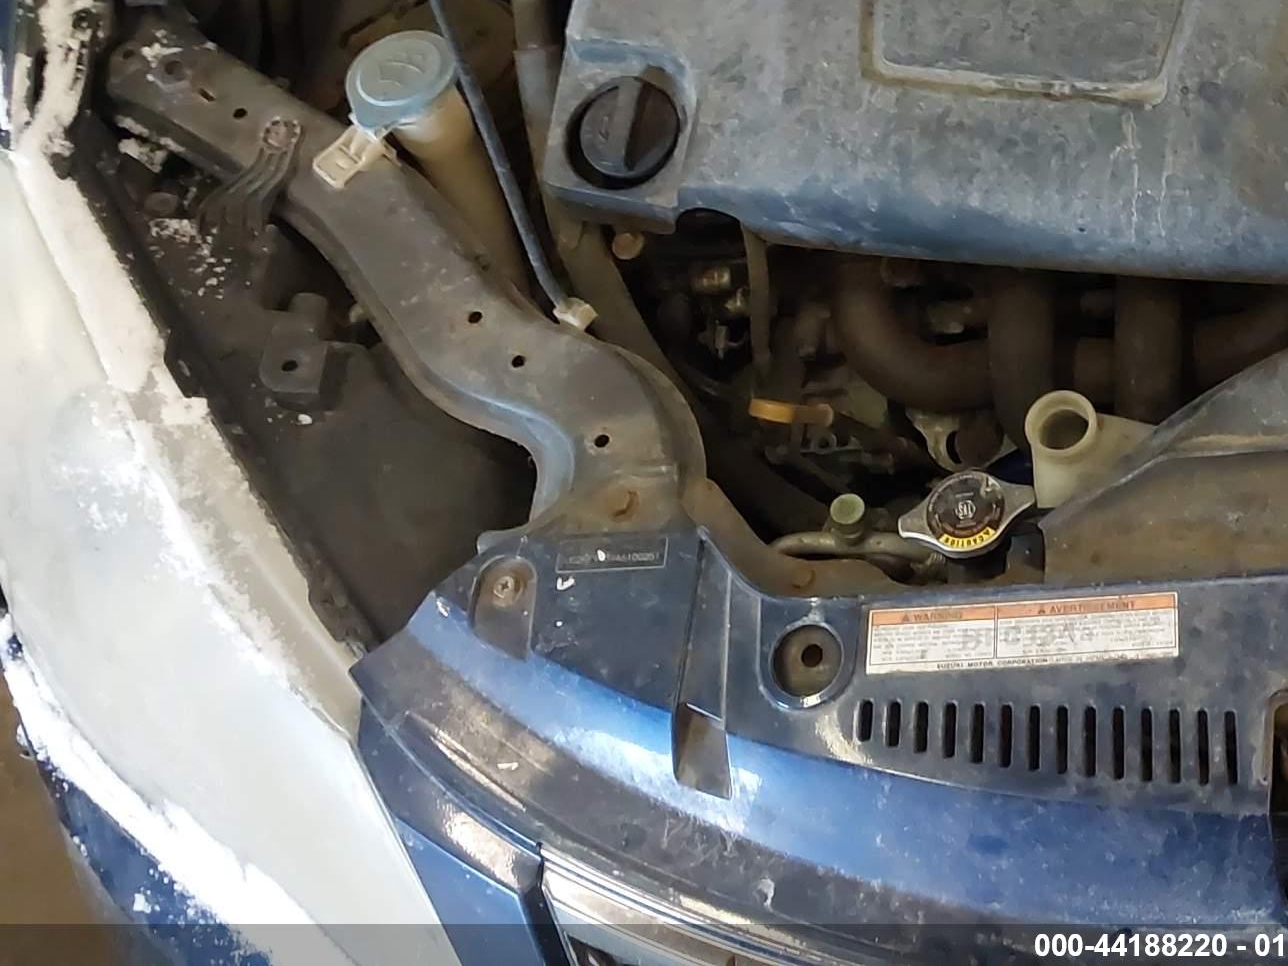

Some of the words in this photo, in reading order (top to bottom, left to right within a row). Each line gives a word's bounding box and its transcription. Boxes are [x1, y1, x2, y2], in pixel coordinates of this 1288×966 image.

[1049, 600, 1136, 614] AVERTISSEMENT
[913, 610, 964, 622] WARNING
[937, 662, 964, 670] SUZUKI
[967, 660, 994, 668] MOTOR
[997, 657, 1049, 667] CORPORATION
